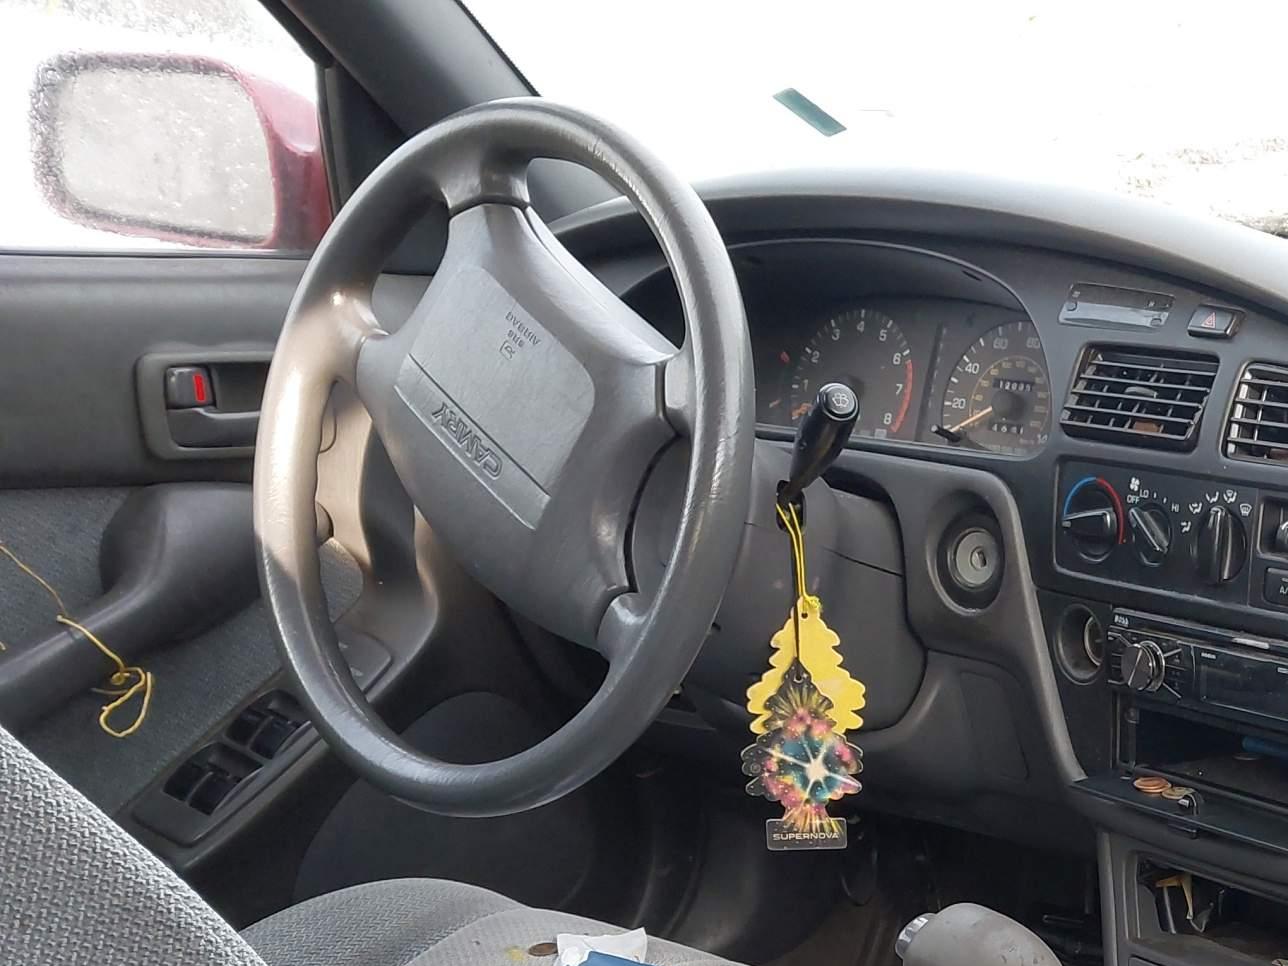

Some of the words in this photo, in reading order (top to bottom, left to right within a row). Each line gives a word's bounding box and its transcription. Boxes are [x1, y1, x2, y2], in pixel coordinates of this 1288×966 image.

[857, 321, 865, 332] 4
[832, 328, 841, 340] 3
[880, 329, 888, 341] 5
[811, 350, 821, 363] 2
[893, 352, 902, 365] 6
[965, 362, 980, 374] 40
[803, 379, 809, 392] 1
[896, 383, 904, 395] 7
[952, 398, 966, 409] 20
[883, 412, 893, 425] 8
[431, 402, 504, 480] CAMRY
[1126, 495, 1140, 504] OFF
[1140, 489, 1150, 498] LO
[1171, 502, 1180, 512] HI
[772, 832, 839, 841] SUPERNOVA
